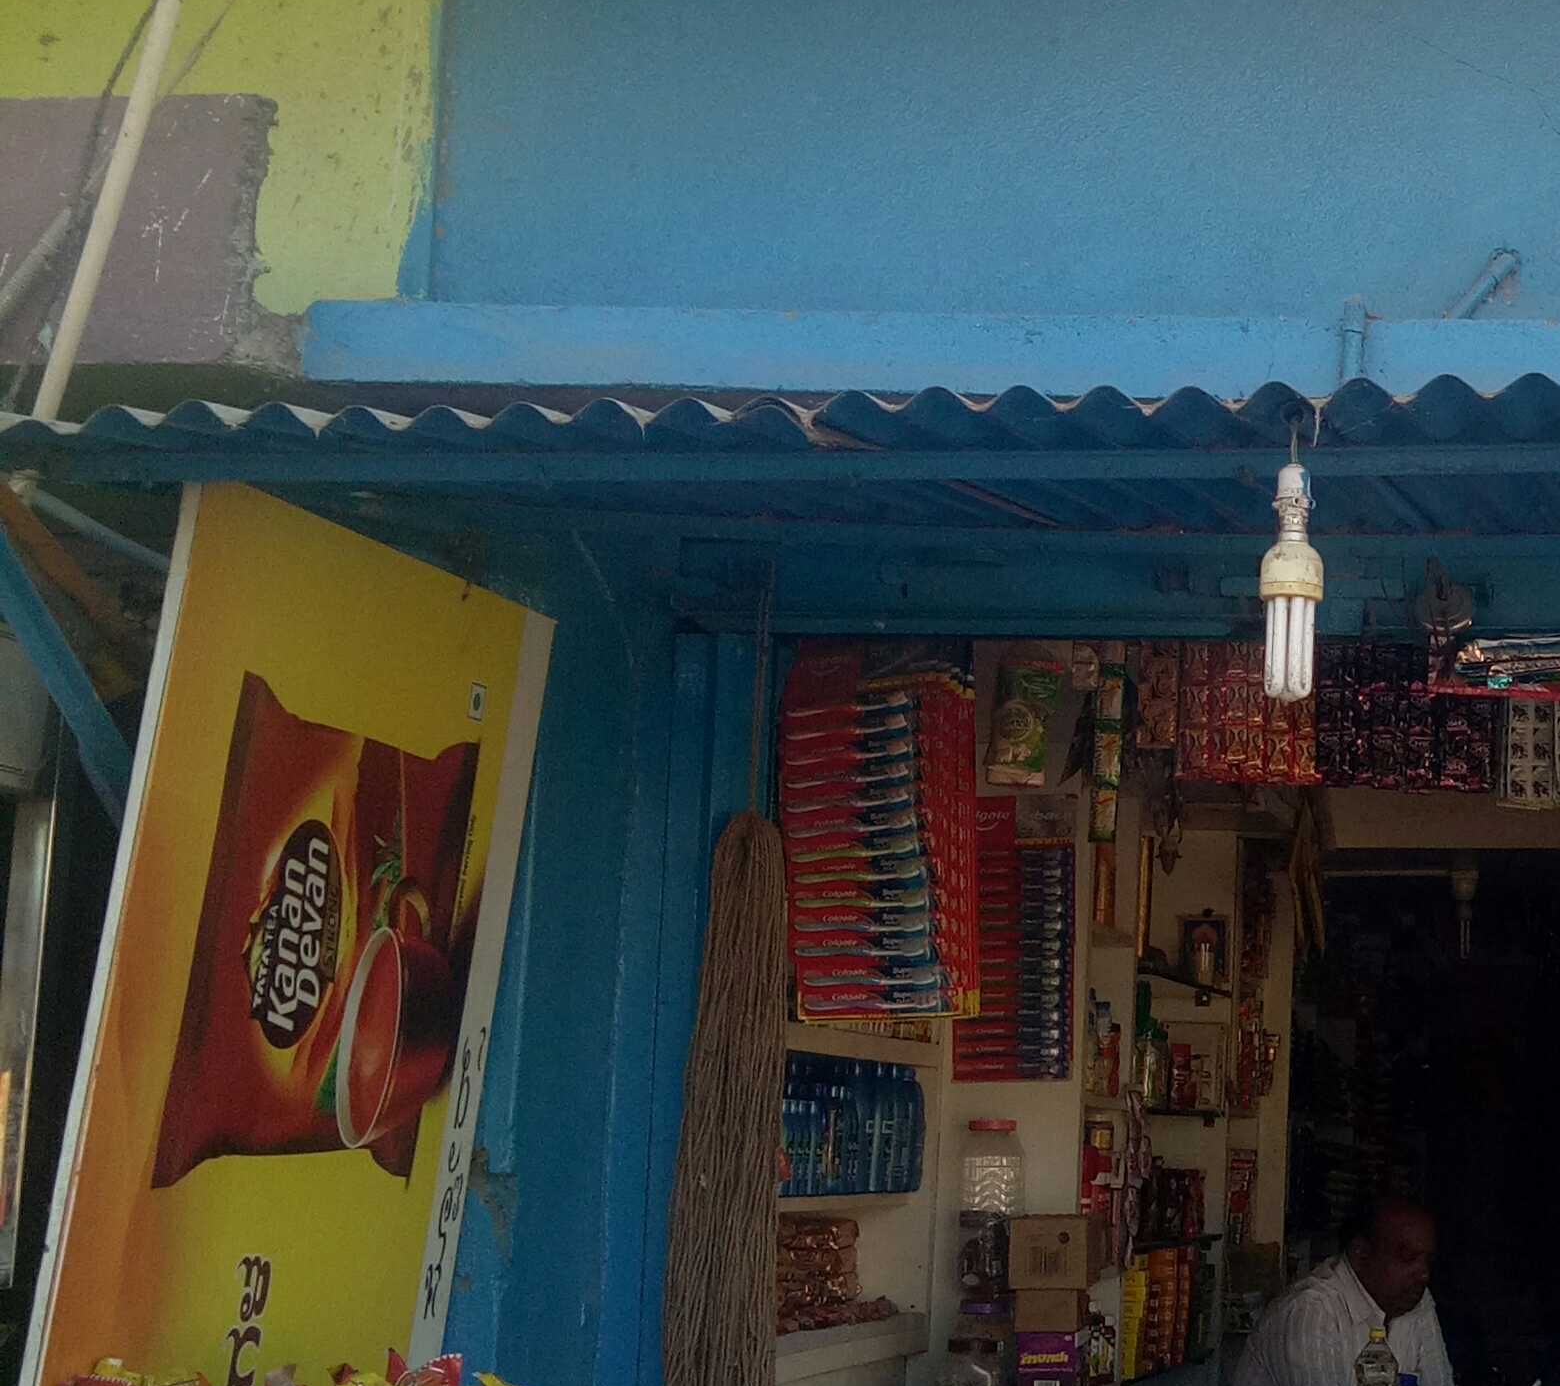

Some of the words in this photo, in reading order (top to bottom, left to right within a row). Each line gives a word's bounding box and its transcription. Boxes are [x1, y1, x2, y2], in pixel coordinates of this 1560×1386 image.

[252, 945, 272, 1009] TATA
[266, 858, 306, 1031] Kanan
[295, 836, 329, 1008] Devan
